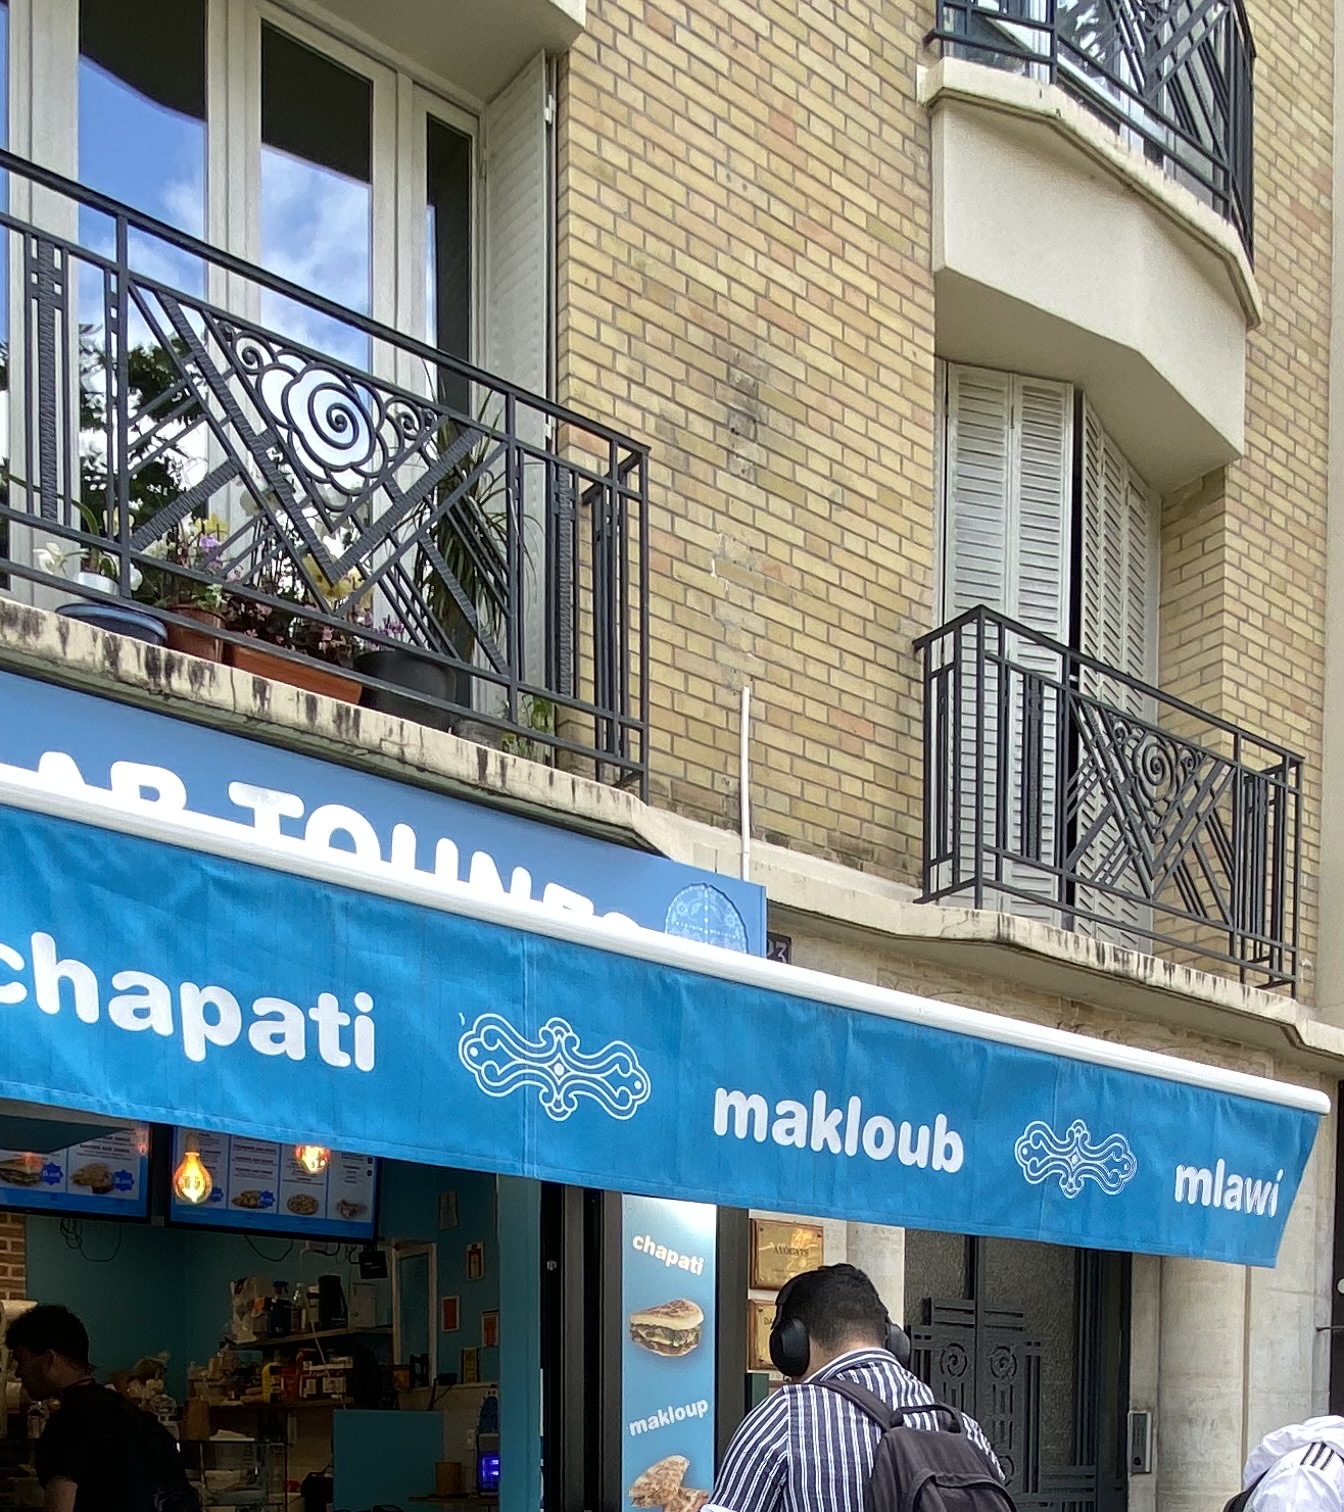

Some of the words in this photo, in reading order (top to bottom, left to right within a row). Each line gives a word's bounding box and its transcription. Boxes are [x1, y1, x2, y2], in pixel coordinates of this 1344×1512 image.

[713, 1088, 964, 1174] makloub
[1174, 1158, 1285, 1218] mlawi
[632, 1233, 705, 1277] chapati
[629, 1399, 709, 1437] makloup
